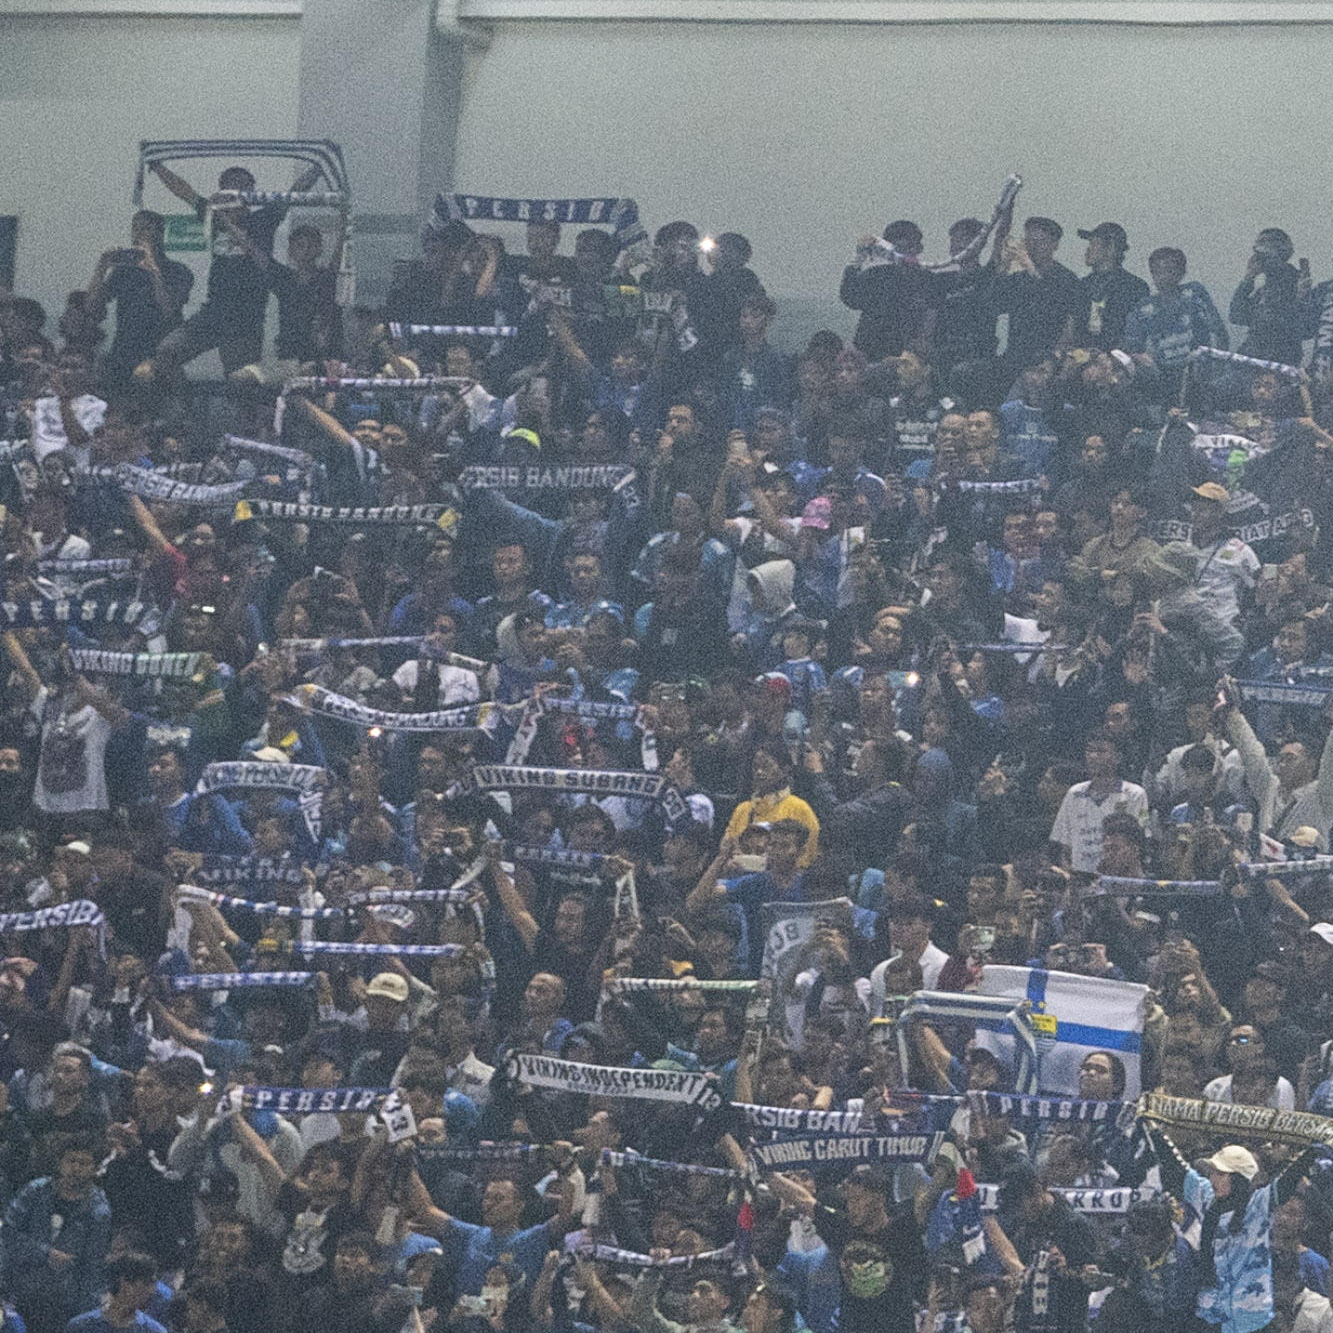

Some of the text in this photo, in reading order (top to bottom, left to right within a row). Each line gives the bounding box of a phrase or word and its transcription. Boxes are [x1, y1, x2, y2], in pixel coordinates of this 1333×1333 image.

[466, 198, 605, 223] PERSIB
[481, 766, 664, 795] VIKING SUBANG
[257, 1091, 376, 1111] PERSIB
[1000, 1096, 1108, 1120] PERSIB
[1203, 1102, 1270, 1128] PERSIB
[876, 1134, 928, 1157] TIMUR
